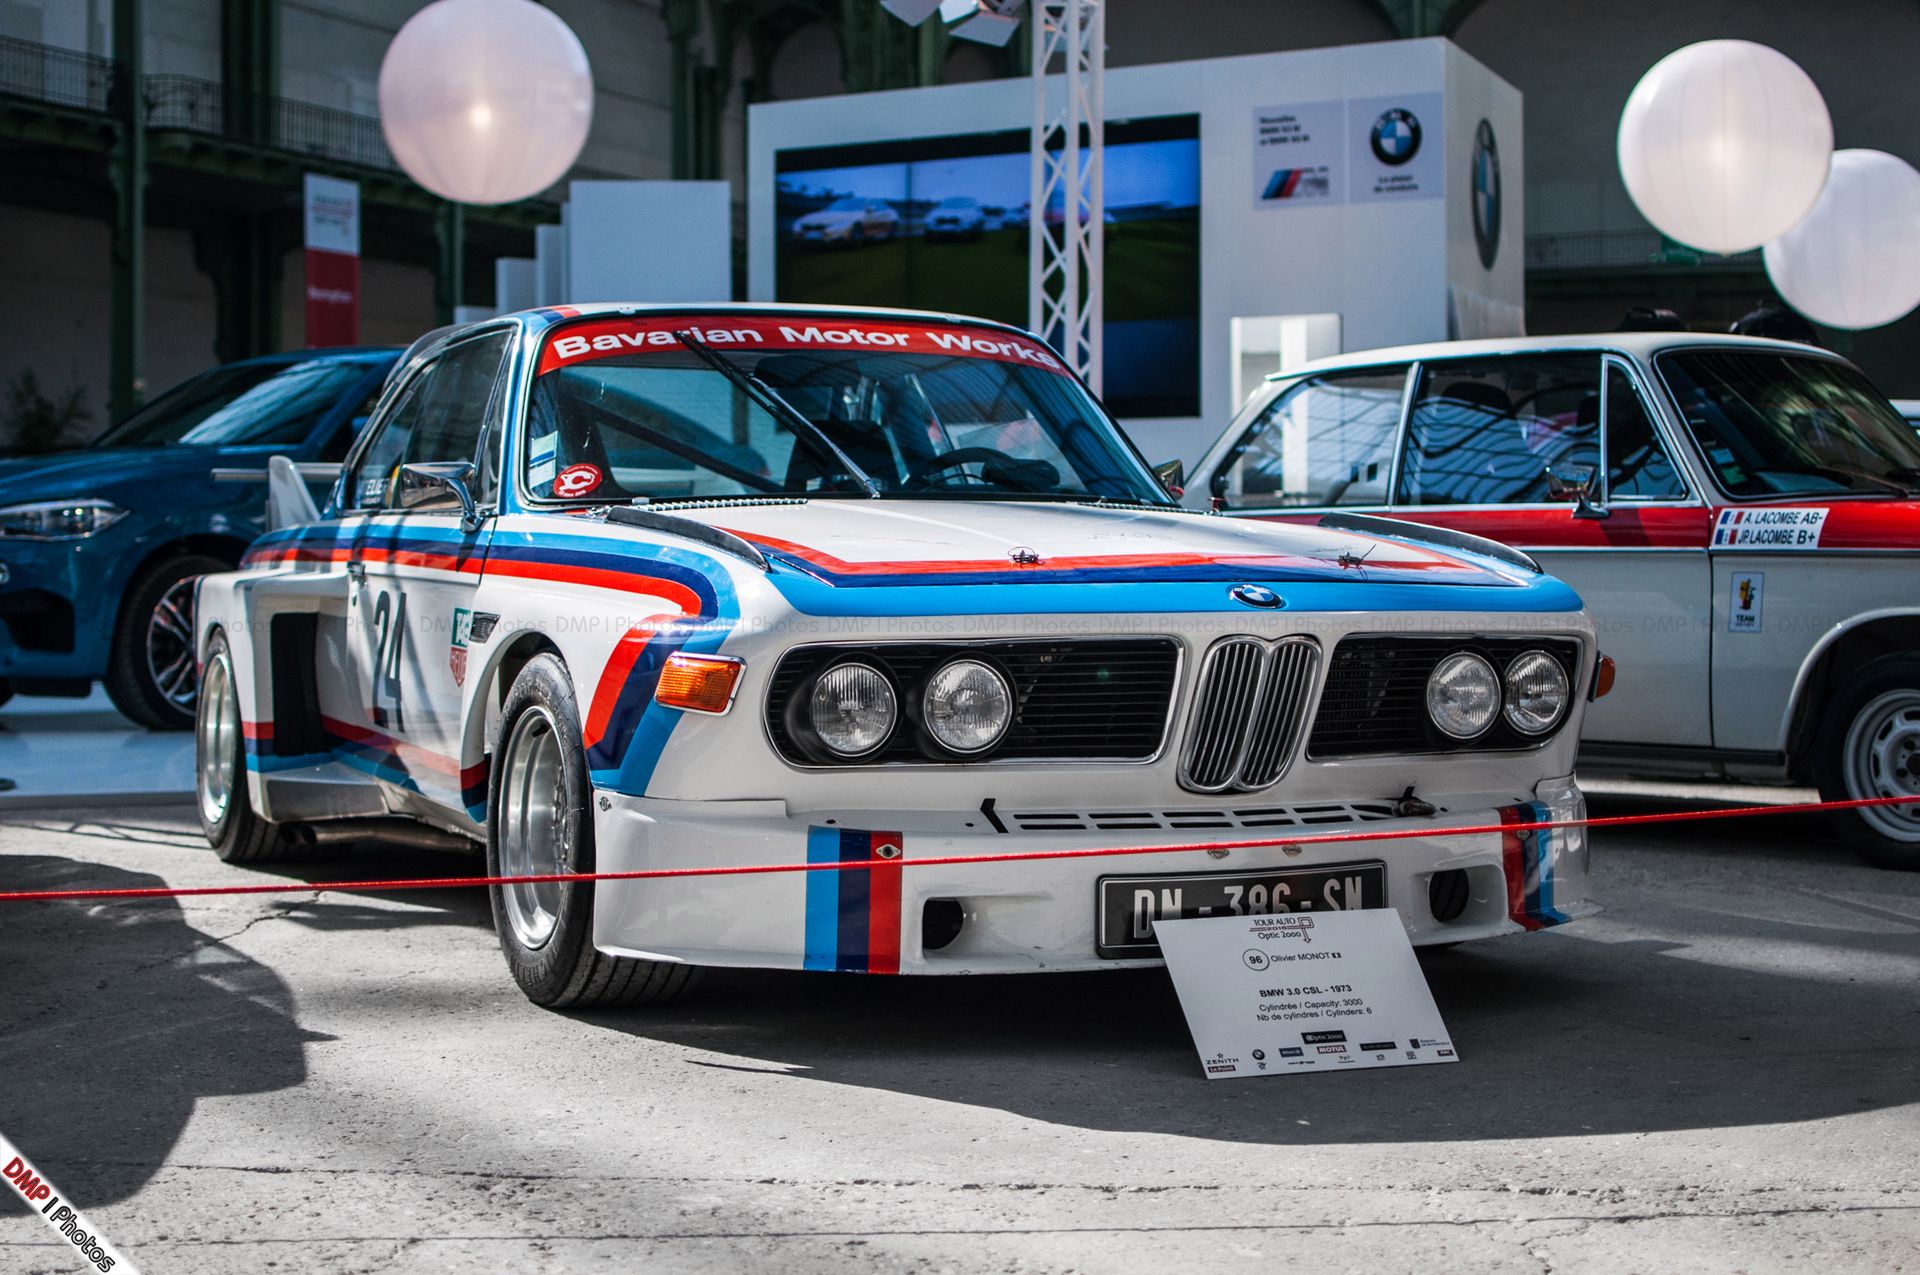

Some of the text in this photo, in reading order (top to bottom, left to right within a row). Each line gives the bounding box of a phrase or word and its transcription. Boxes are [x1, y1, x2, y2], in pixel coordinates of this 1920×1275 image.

[553, 327, 1061, 370] Bavarian Motor Works
[1755, 511, 1801, 524] LACOMBE
[1797, 530, 1816, 544] B+
[1735, 614, 1756, 623] TEAM
[373, 590, 407, 733] 24
[1134, 888, 1183, 938] DN
[1224, 883, 1292, 916] 386
[1323, 876, 1363, 912] SN
[1253, 919, 1275, 927] TOUR
[1258, 930, 1302, 941] Optic 2000
[1249, 952, 1330, 965] 96 Olivier MONOT
[1260, 989, 1285, 998] BMW
[1287, 987, 1301, 996] 3.0
[1302, 986, 1323, 995] CSL
[1331, 984, 1352, 993] 1973
[1259, 1002, 1298, 1013] Cylindrée
[1304, 999, 1341, 1010] Capacity:
[1343, 998, 1363, 1007] 3000
[1257, 1014, 1269, 1022] Nb
[1271, 1012, 1282, 1021] de
[1284, 1010, 1319, 1021] cylindres
[1326, 1007, 1365, 1018] Cylinders:
[1366, 1006, 1373, 1015] 6
[1206, 1057, 1239, 1065] ZENITH
